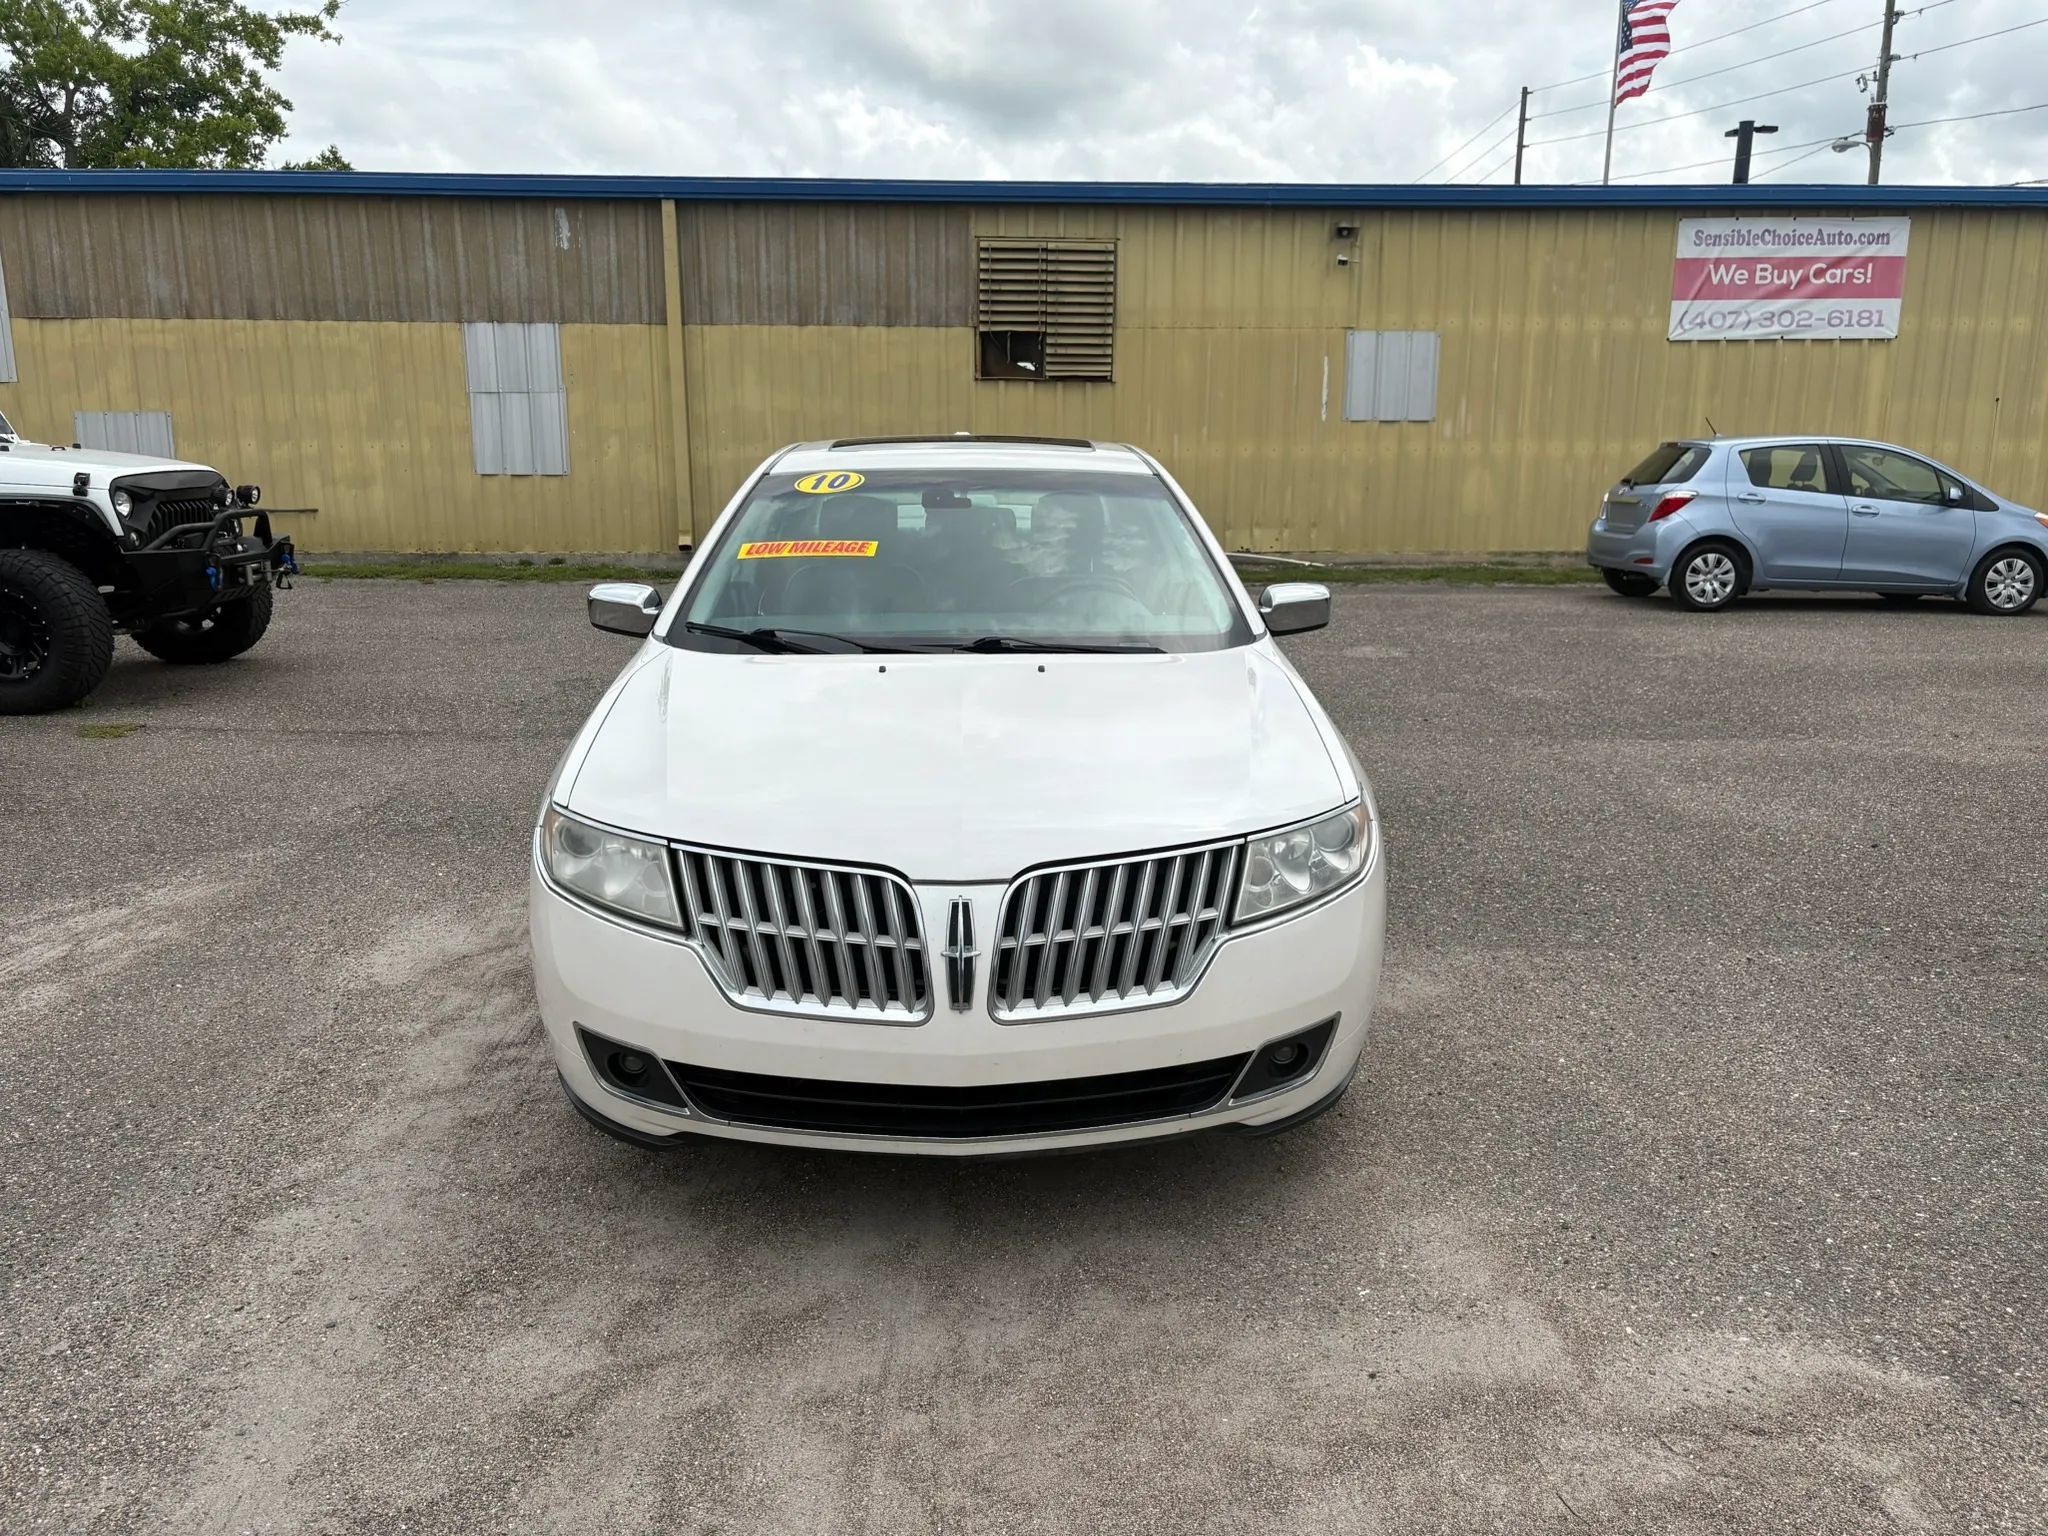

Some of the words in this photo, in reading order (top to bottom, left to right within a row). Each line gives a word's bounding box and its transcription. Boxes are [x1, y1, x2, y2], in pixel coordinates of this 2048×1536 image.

[1693, 228, 1891, 247] SensibleChoiceAuto.com
[1709, 263, 1748, 285] We
[1755, 263, 1803, 290] Buy
[1809, 263, 1873, 284] Cars!
[1678, 309, 1751, 332] (407)
[1758, 309, 1885, 329] 302-6181
[811, 474, 851, 490] 10
[746, 543, 789, 556] LOW
[788, 542, 870, 554] MILEAGE
